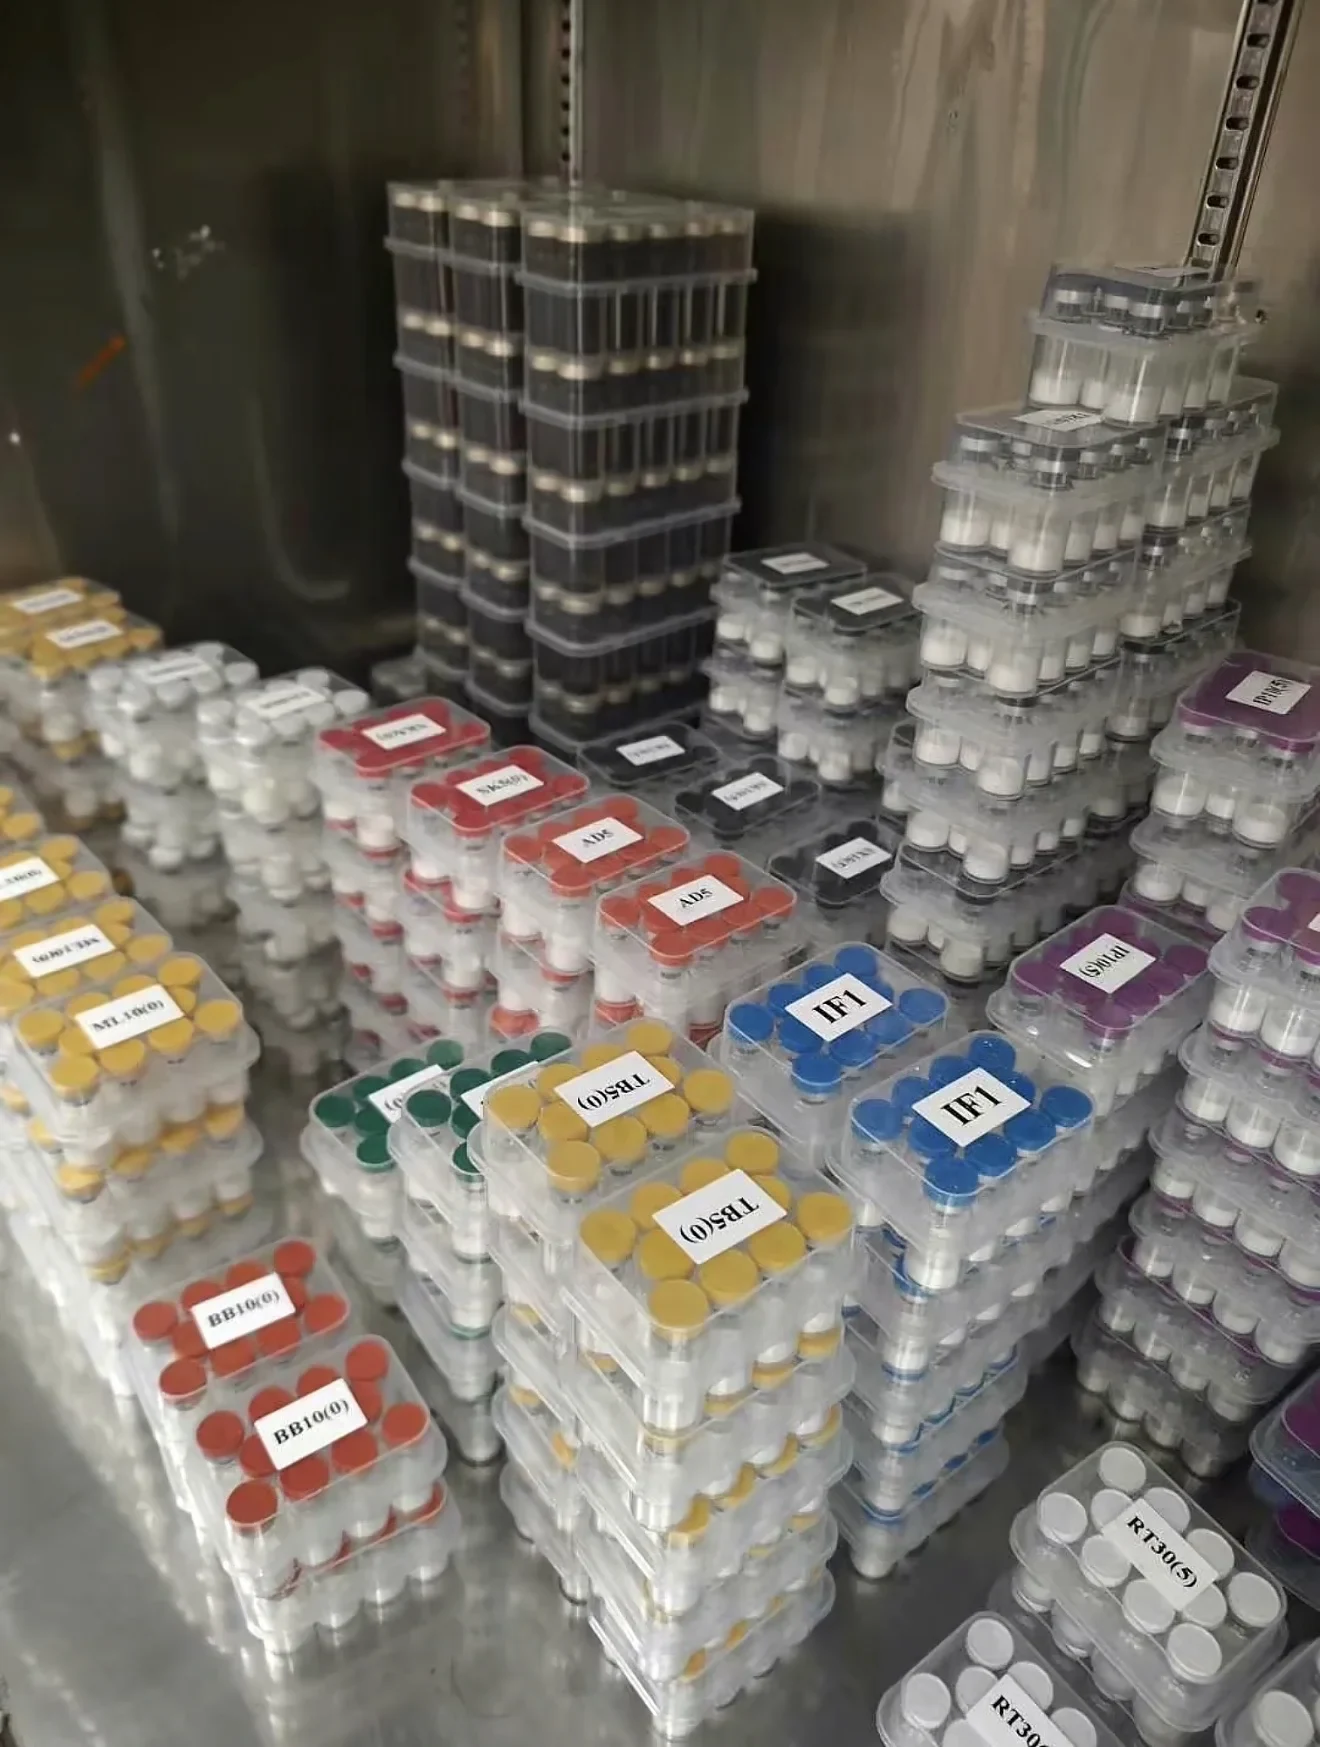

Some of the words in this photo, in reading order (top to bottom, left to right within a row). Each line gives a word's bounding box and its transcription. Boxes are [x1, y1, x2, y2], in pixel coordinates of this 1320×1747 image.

[582, 829, 614, 847] AD5
[679, 888, 713, 909] AD5
[1078, 944, 1130, 978] IP10(5)
[812, 989, 867, 1024] IF1
[577, 1073, 651, 1111] TB5(0)
[940, 1086, 1002, 1126] IF1
[680, 1197, 760, 1244] TB5(0)
[207, 1290, 280, 1328] BB10(0)
[273, 1399, 350, 1445] BB10(0)
[1126, 1515, 1199, 1590] RT30(5)
